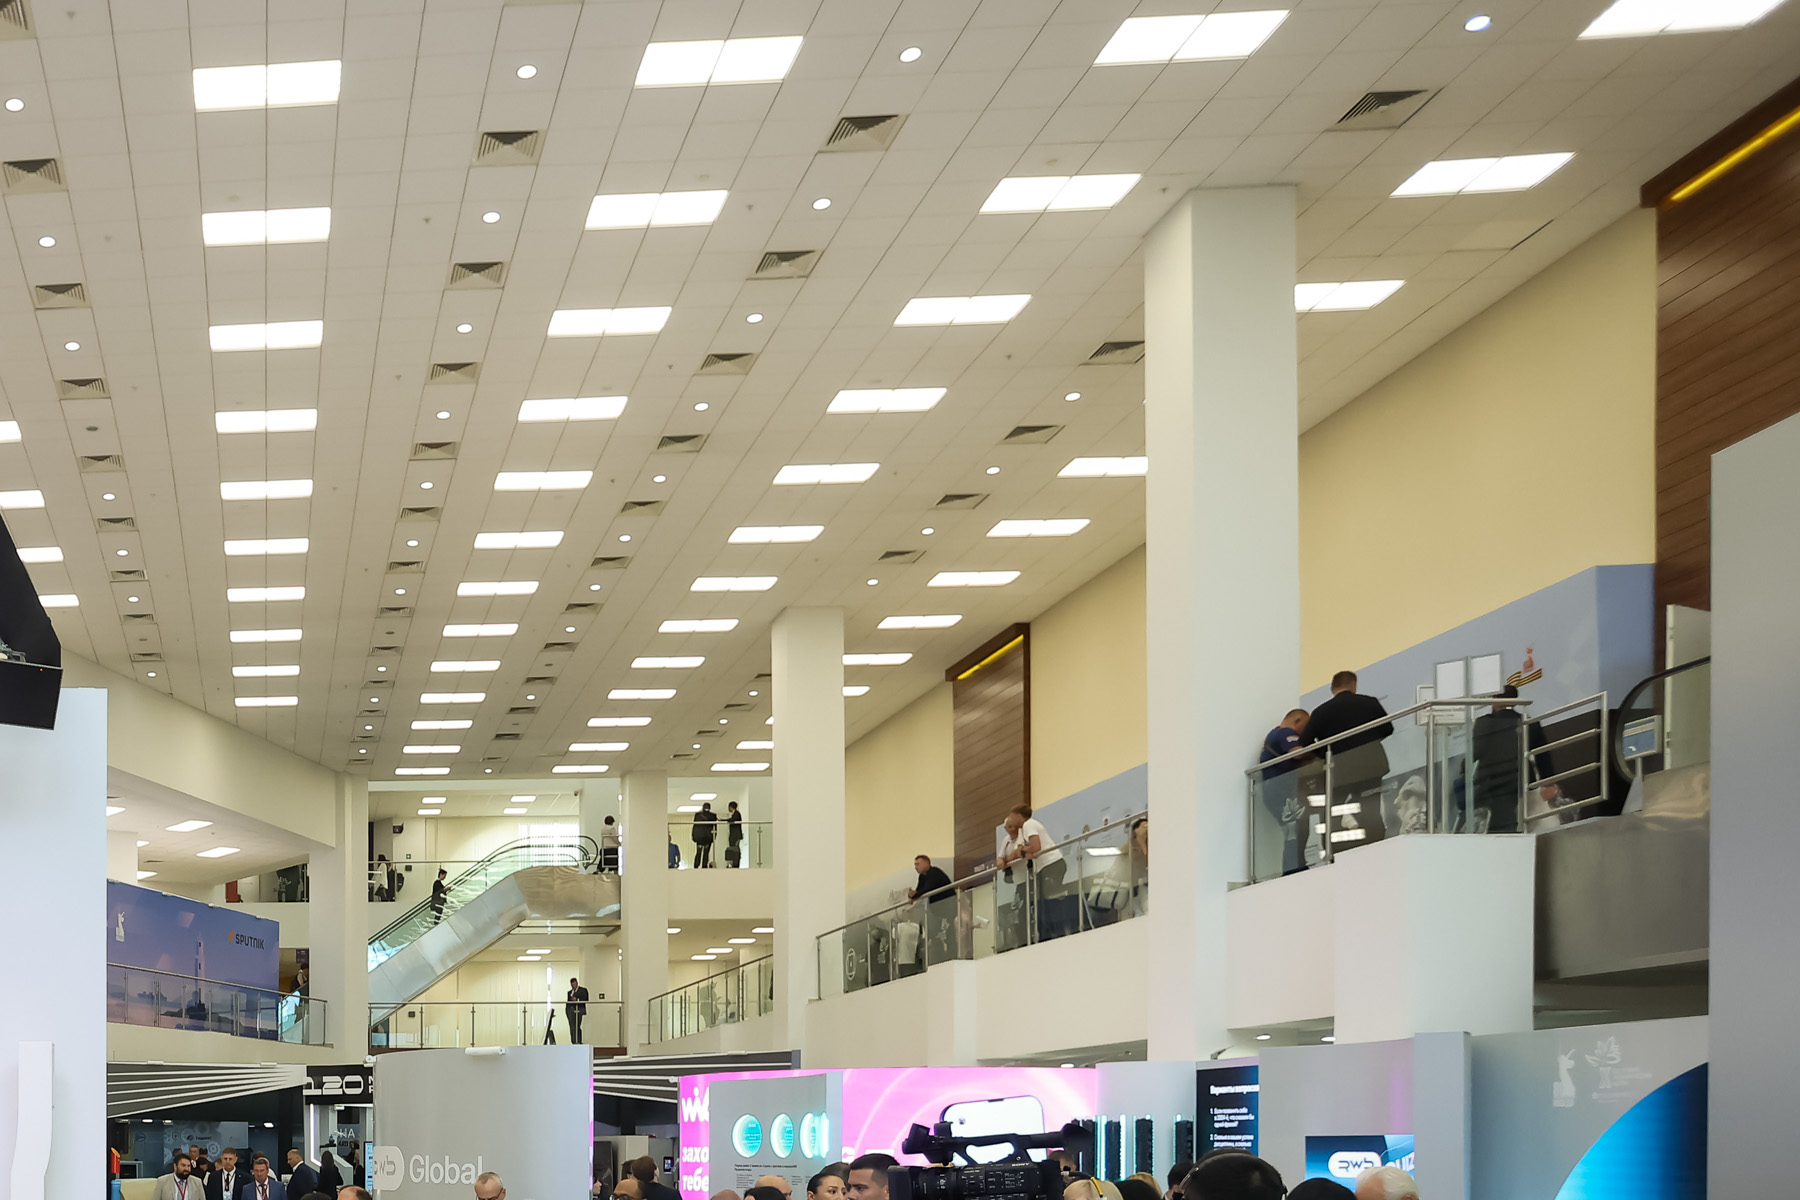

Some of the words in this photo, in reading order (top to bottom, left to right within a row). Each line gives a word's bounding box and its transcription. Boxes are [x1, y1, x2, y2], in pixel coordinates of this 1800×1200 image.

[235, 932, 265, 950] SPUTNIK
[302, 1075, 364, 1096] 120
[409, 1154, 483, 1185] Global
